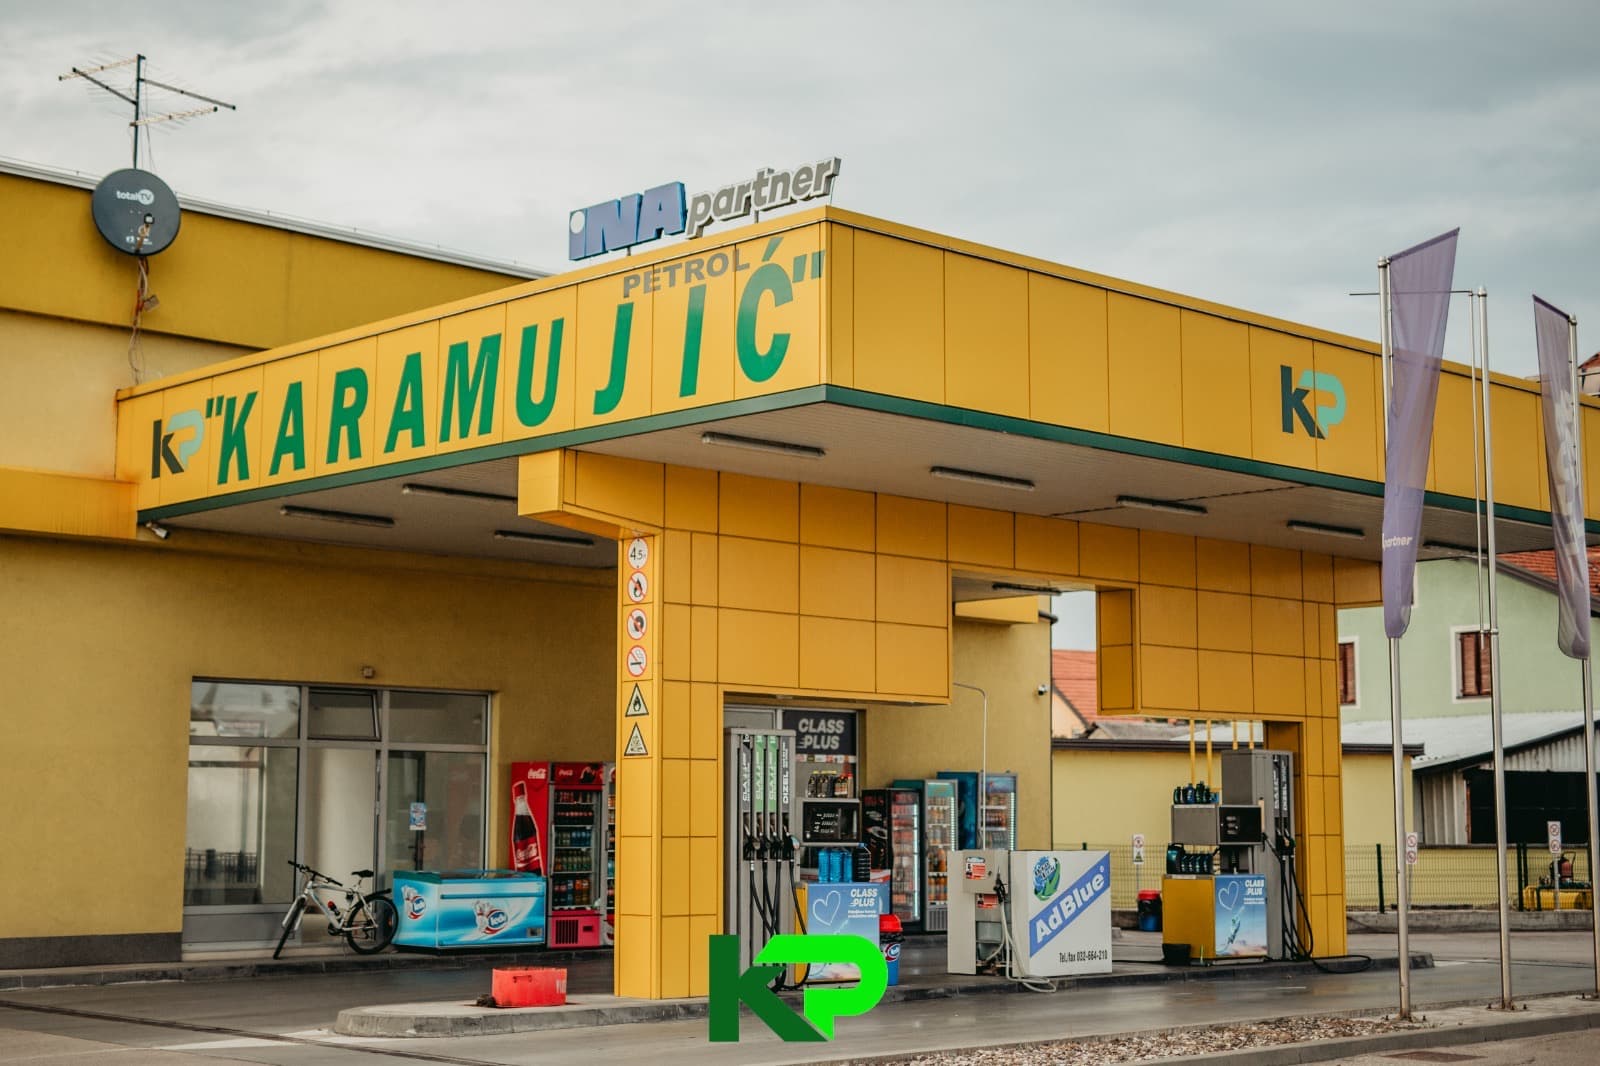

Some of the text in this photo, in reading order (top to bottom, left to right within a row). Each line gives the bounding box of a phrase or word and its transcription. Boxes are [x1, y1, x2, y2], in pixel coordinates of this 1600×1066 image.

[686, 156, 843, 243] partner
[622, 249, 751, 298] PETROL
[798, 718, 845, 734] CLASS
[801, 734, 841, 751] PLUS
[850, 888, 878, 898] CLASS
[852, 898, 876, 908] PLUS
[1035, 873, 1105, 945] AdBlue
